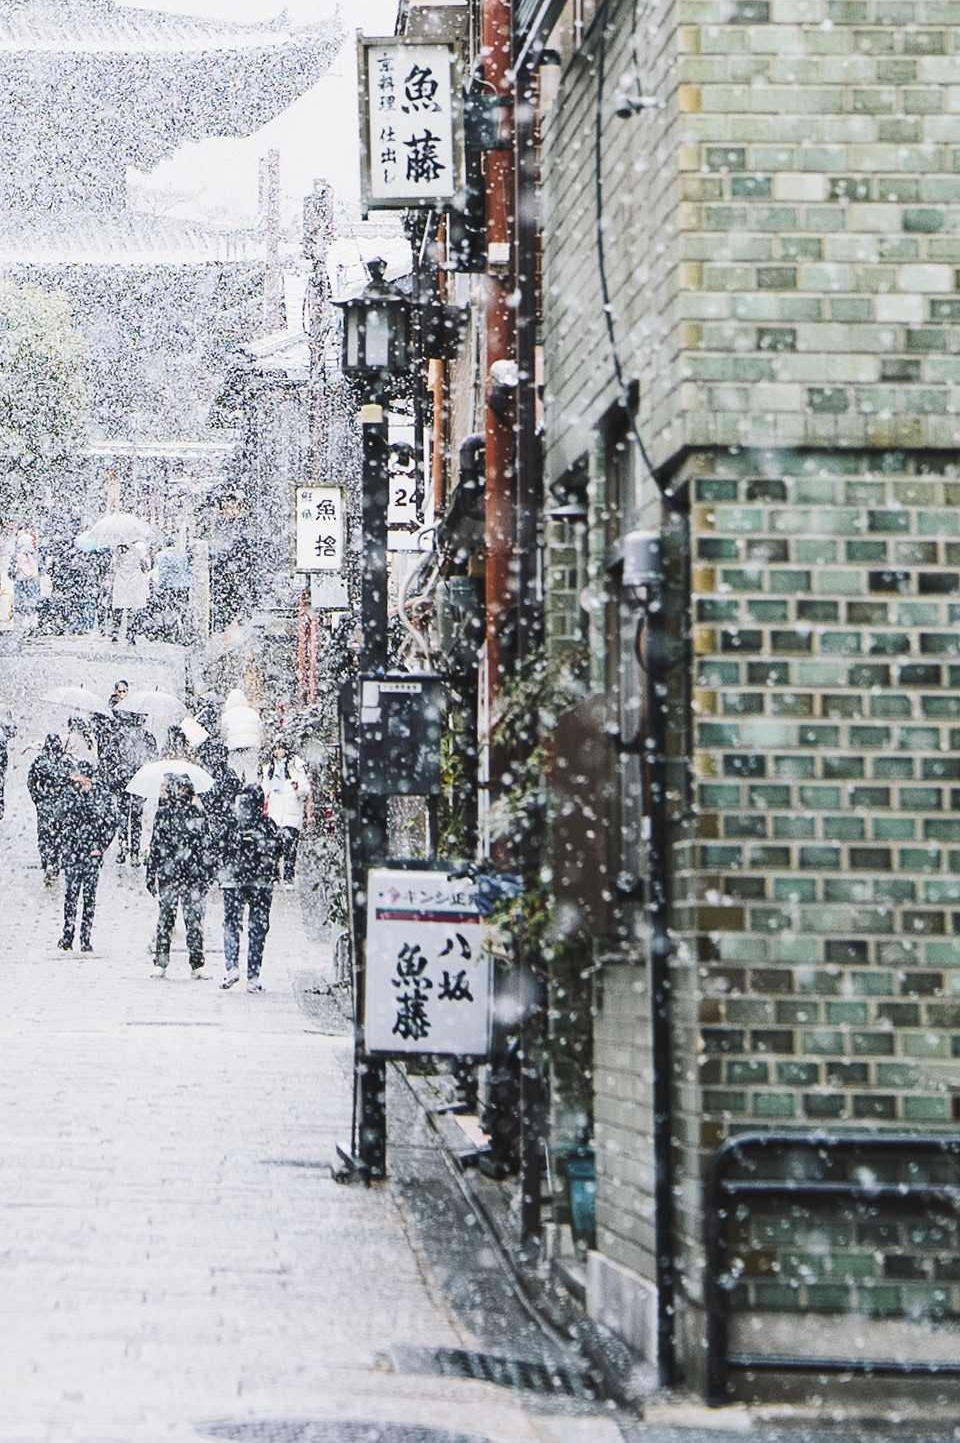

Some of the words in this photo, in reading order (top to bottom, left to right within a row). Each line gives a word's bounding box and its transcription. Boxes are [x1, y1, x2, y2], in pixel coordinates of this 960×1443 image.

[401, 64, 446, 184] 魚藤
[391, 943, 434, 1040] 魚藤
[438, 933, 474, 1002] 八坂
